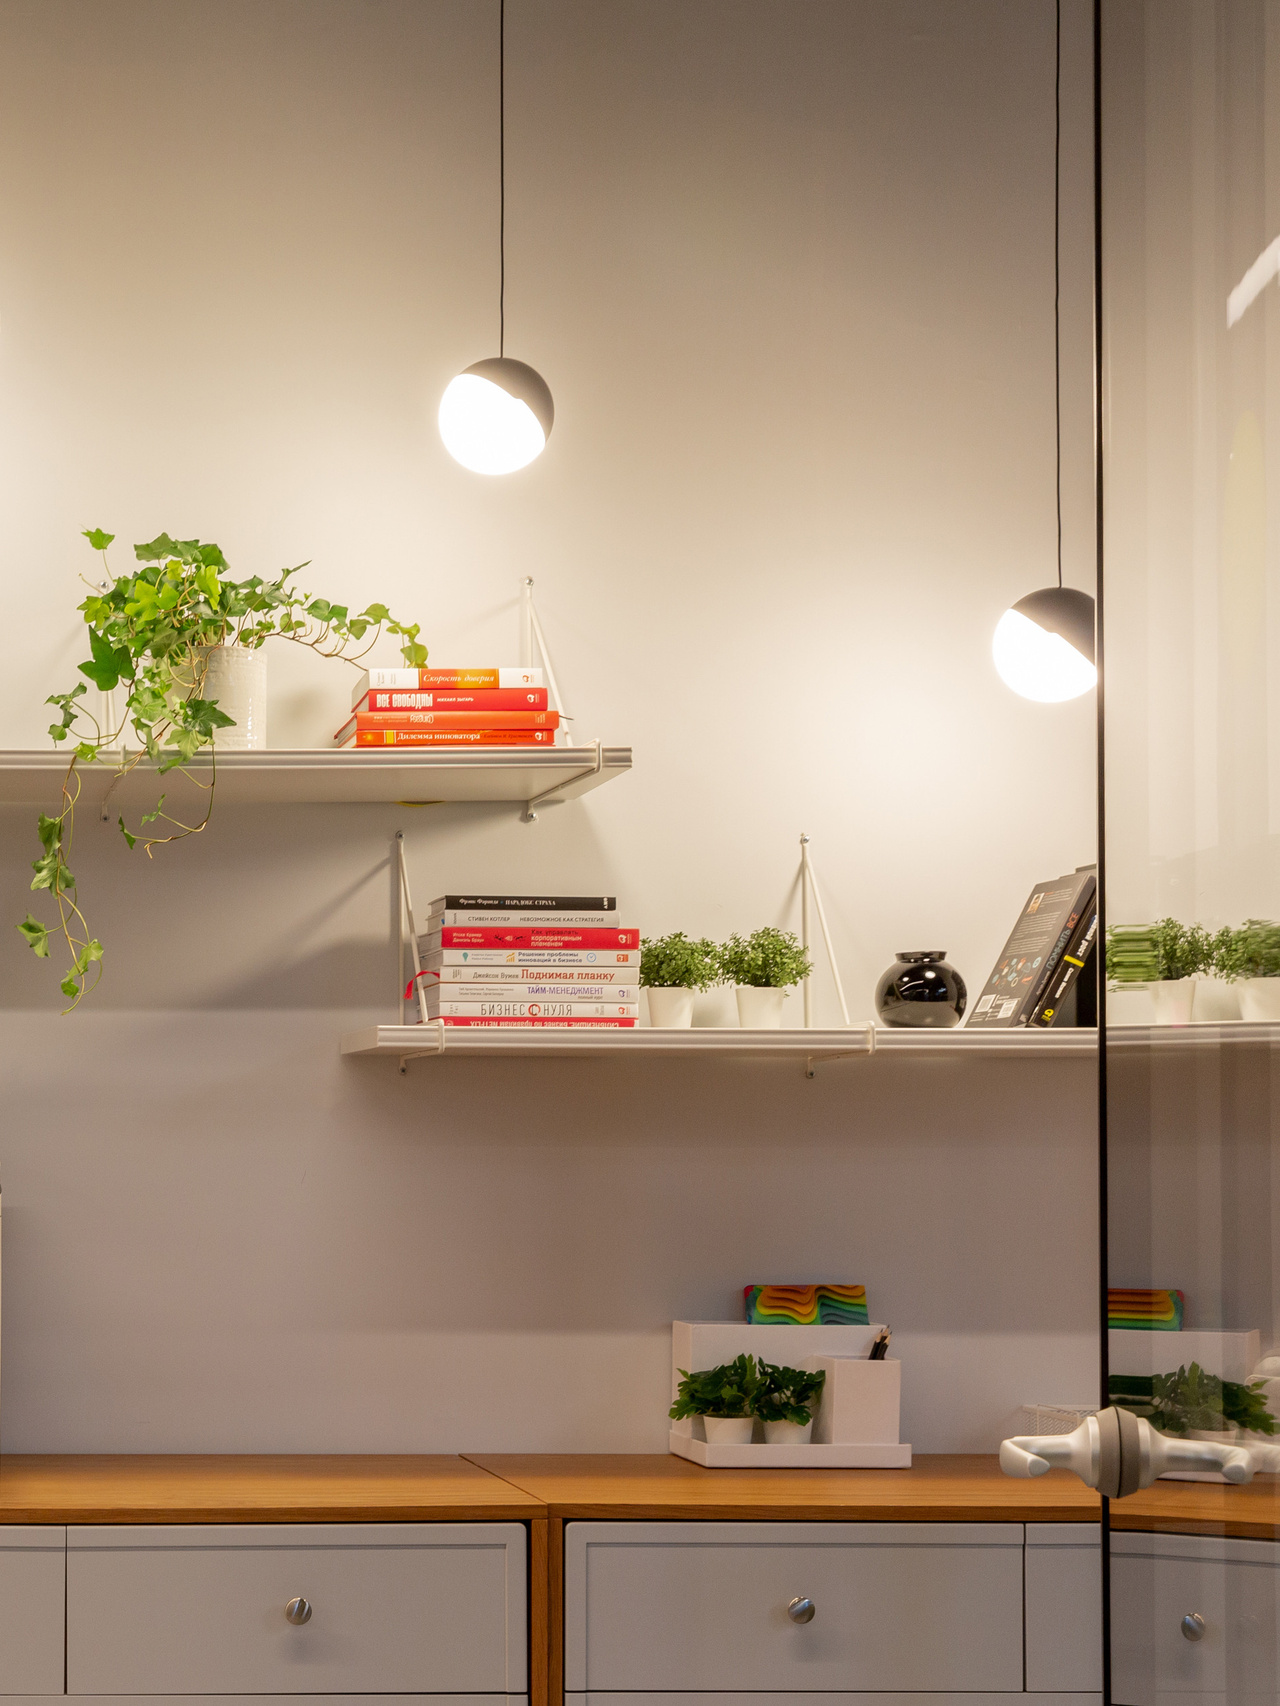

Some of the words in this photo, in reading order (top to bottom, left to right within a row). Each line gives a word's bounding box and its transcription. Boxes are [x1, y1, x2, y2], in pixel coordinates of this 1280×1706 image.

[424, 674, 461, 684] Скорость
[464, 674, 494, 683] доверия
[376, 694, 390, 707] ВСЕ
[392, 693, 433, 709] СВОБОДНЫ
[1046, 928, 1070, 969] ПОМНИТЬ
[1066, 912, 1079, 928] ВСЕ
[521, 969, 574, 980] Поднимая
[577, 972, 615, 982] планку
[527, 985, 603, 995] ТАЙМ-МЕНЕДЖМЕНТ
[480, 1004, 525, 1016] БИЗНЕС
[543, 1004, 572, 1016] НУЛЯ
